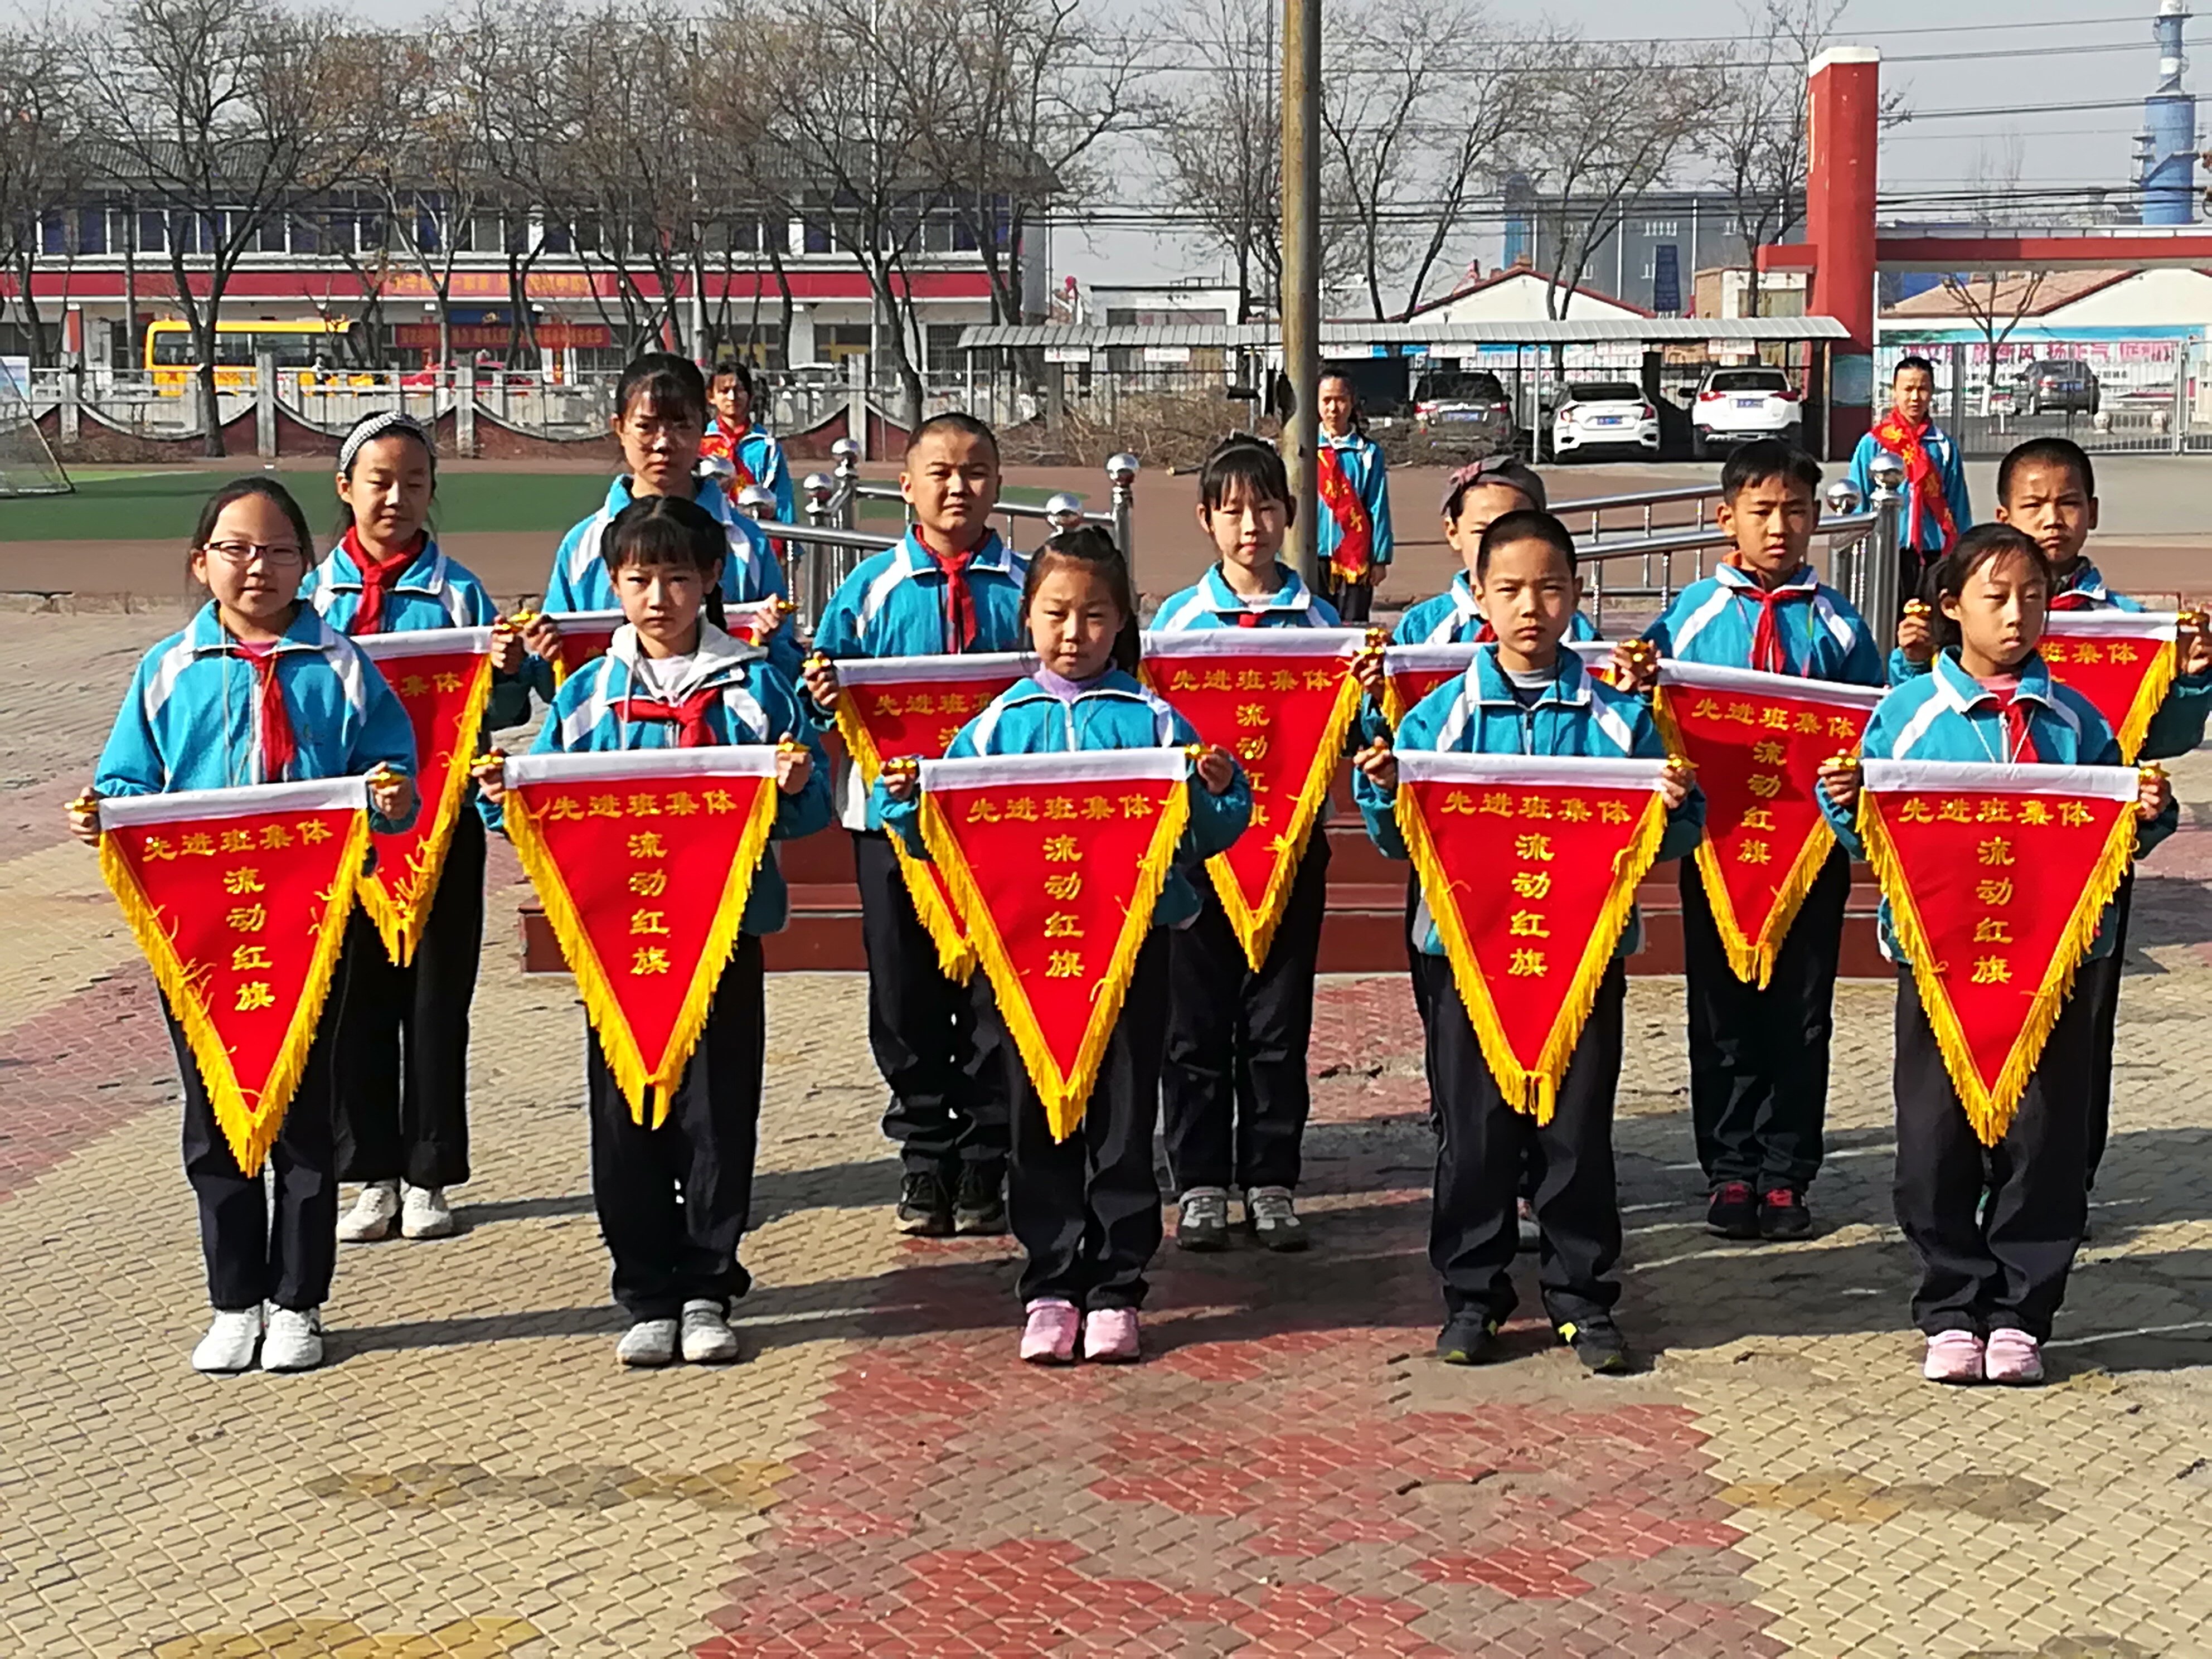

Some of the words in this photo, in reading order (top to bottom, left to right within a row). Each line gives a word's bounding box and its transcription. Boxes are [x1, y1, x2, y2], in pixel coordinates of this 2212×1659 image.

[387, 672, 463, 697] 集体
[1170, 668, 1333, 691] 先进班集体
[1691, 697, 1857, 739] 先进班集体
[549, 789, 738, 821] 先进班集体
[966, 793, 1154, 823] 先进班集体
[1440, 790, 1632, 825] 先进班集体
[1736, 740, 1787, 865] 流动红旗
[1898, 797, 2095, 828] 先进班集体
[142, 818, 334, 862] 先进班集体
[627, 831, 671, 976] 流动红旗
[1042, 833, 1085, 978] 流动红旗
[1507, 832, 1555, 978] 流动红旗
[1971, 836, 2015, 984] 流动红旗
[222, 866, 276, 1012] 流动红旗
